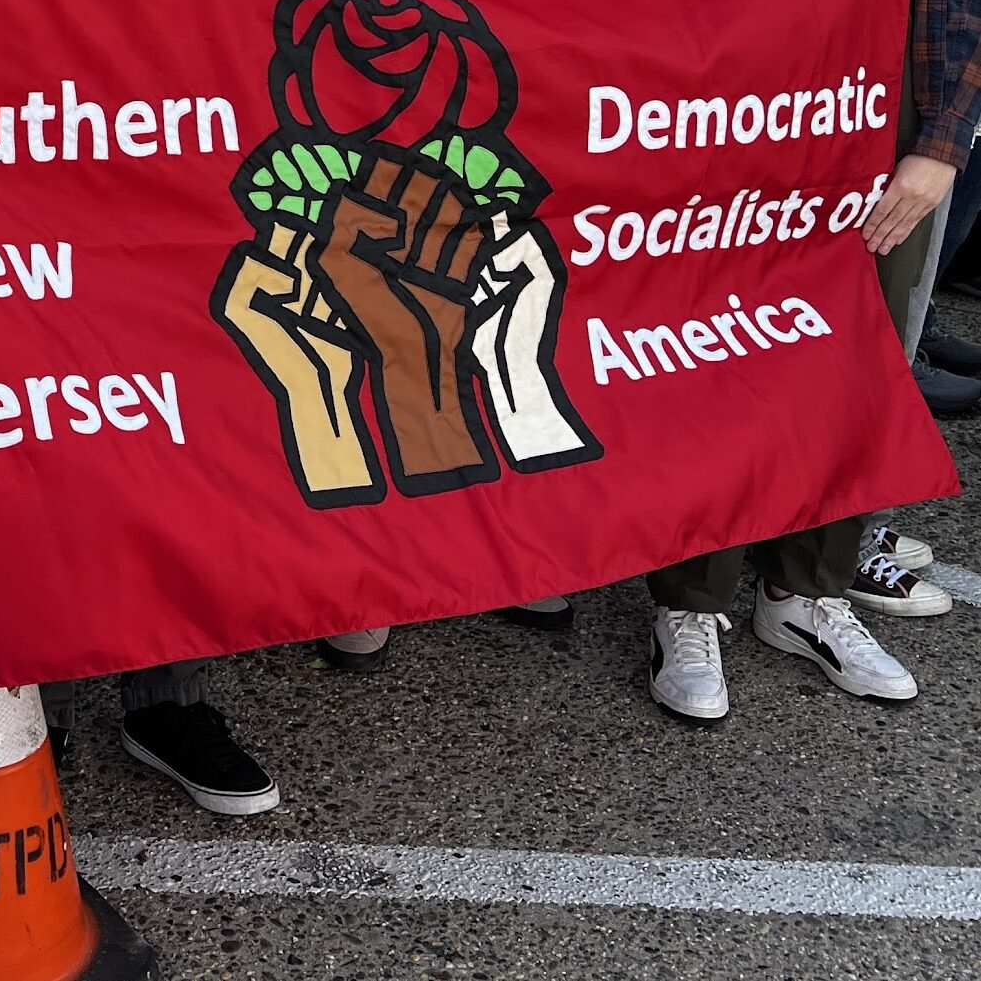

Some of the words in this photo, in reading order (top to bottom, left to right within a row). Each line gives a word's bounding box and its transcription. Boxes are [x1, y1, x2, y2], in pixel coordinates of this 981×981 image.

[588, 66, 886, 153] Democratic
[571, 188, 824, 266] Socialists
[828, 173, 889, 233] of
[587, 293, 833, 385] America
